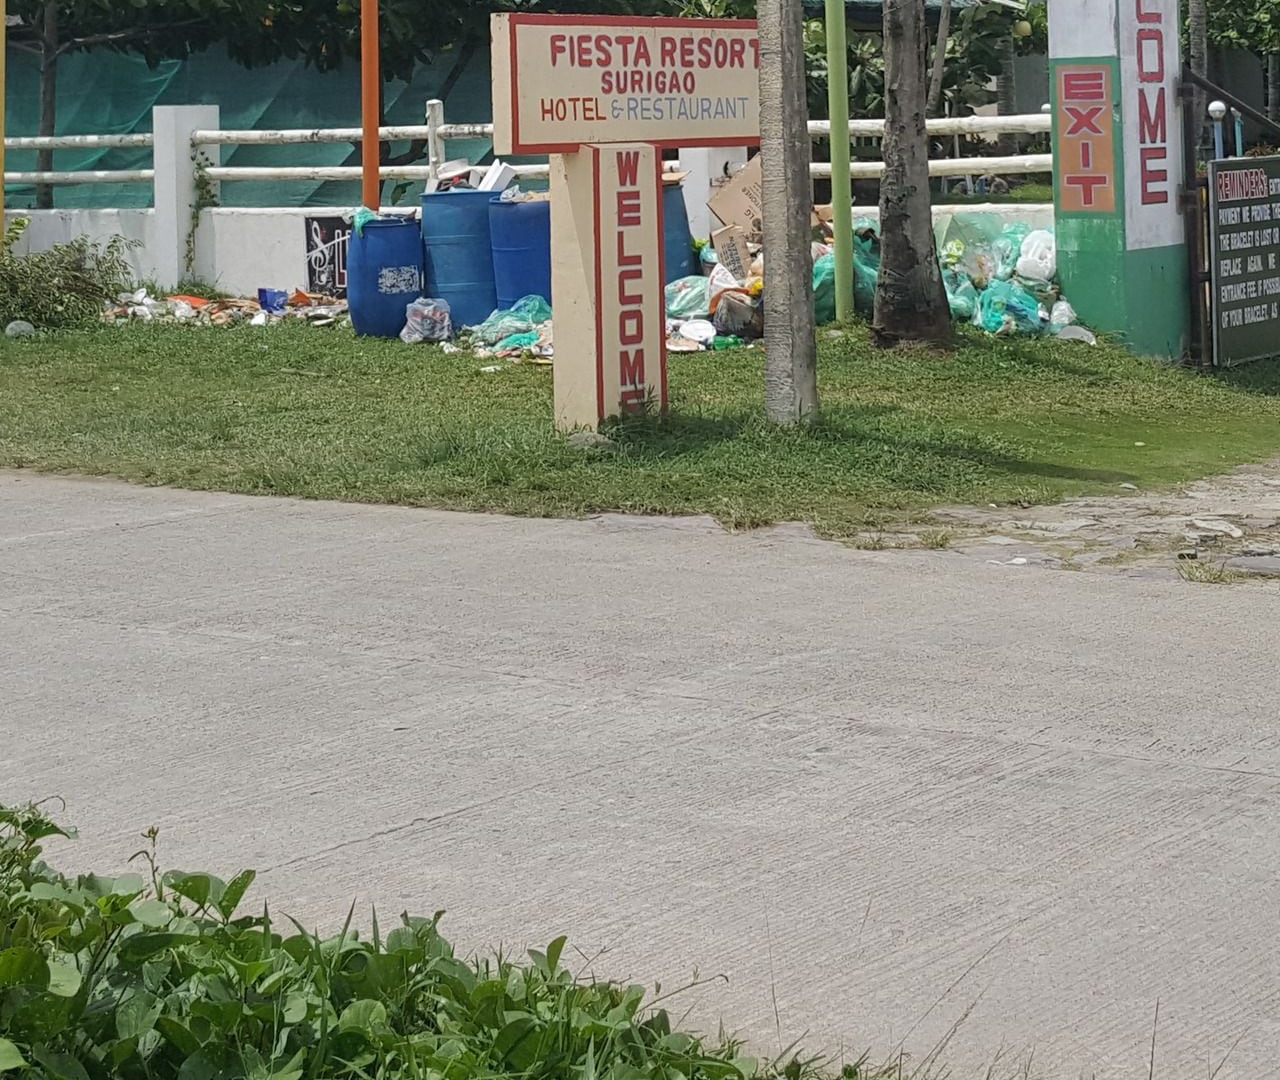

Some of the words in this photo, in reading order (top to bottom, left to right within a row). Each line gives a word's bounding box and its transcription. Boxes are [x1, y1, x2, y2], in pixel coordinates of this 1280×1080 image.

[550, 34, 651, 68] FIESTA
[660, 36, 760, 69] RESORT
[601, 71, 696, 95] SURIGAO
[540, 97, 606, 121] HOTEL
[1062, 71, 1107, 207] EXIT
